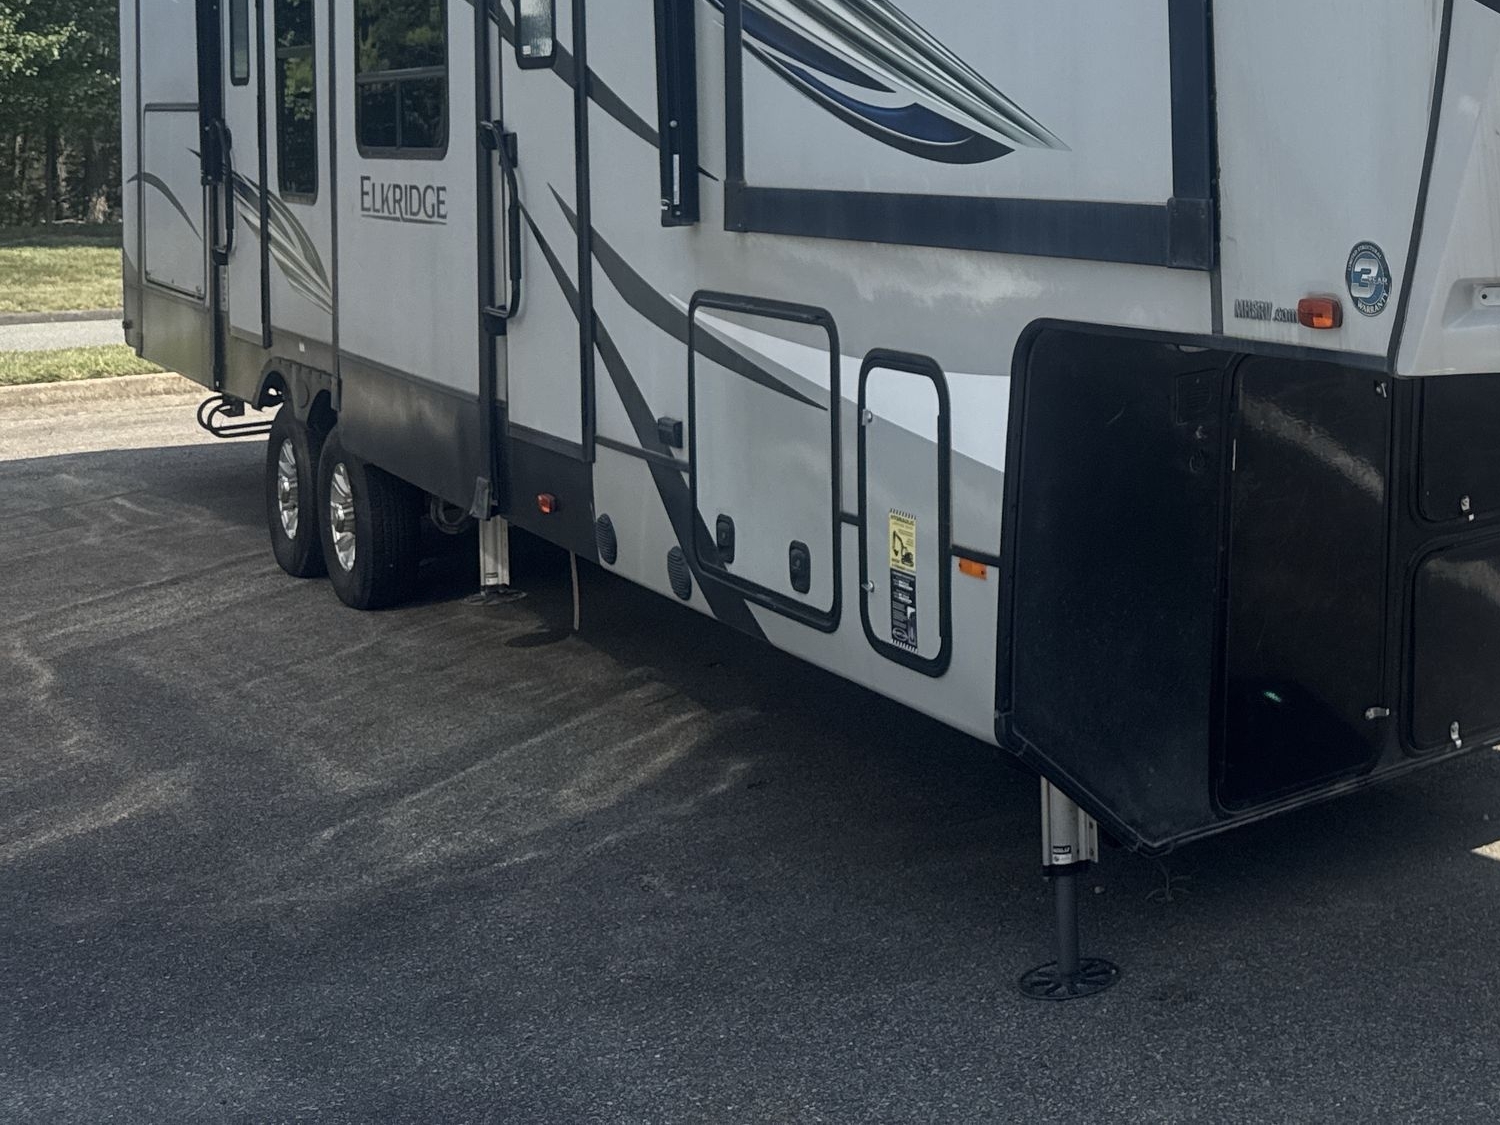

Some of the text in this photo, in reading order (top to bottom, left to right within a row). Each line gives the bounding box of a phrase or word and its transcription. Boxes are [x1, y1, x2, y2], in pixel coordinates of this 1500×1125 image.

[360, 175, 448, 221] ELKRIDGE
[1350, 258, 1379, 299] 3
[1357, 290, 1388, 314] WARRANTY
